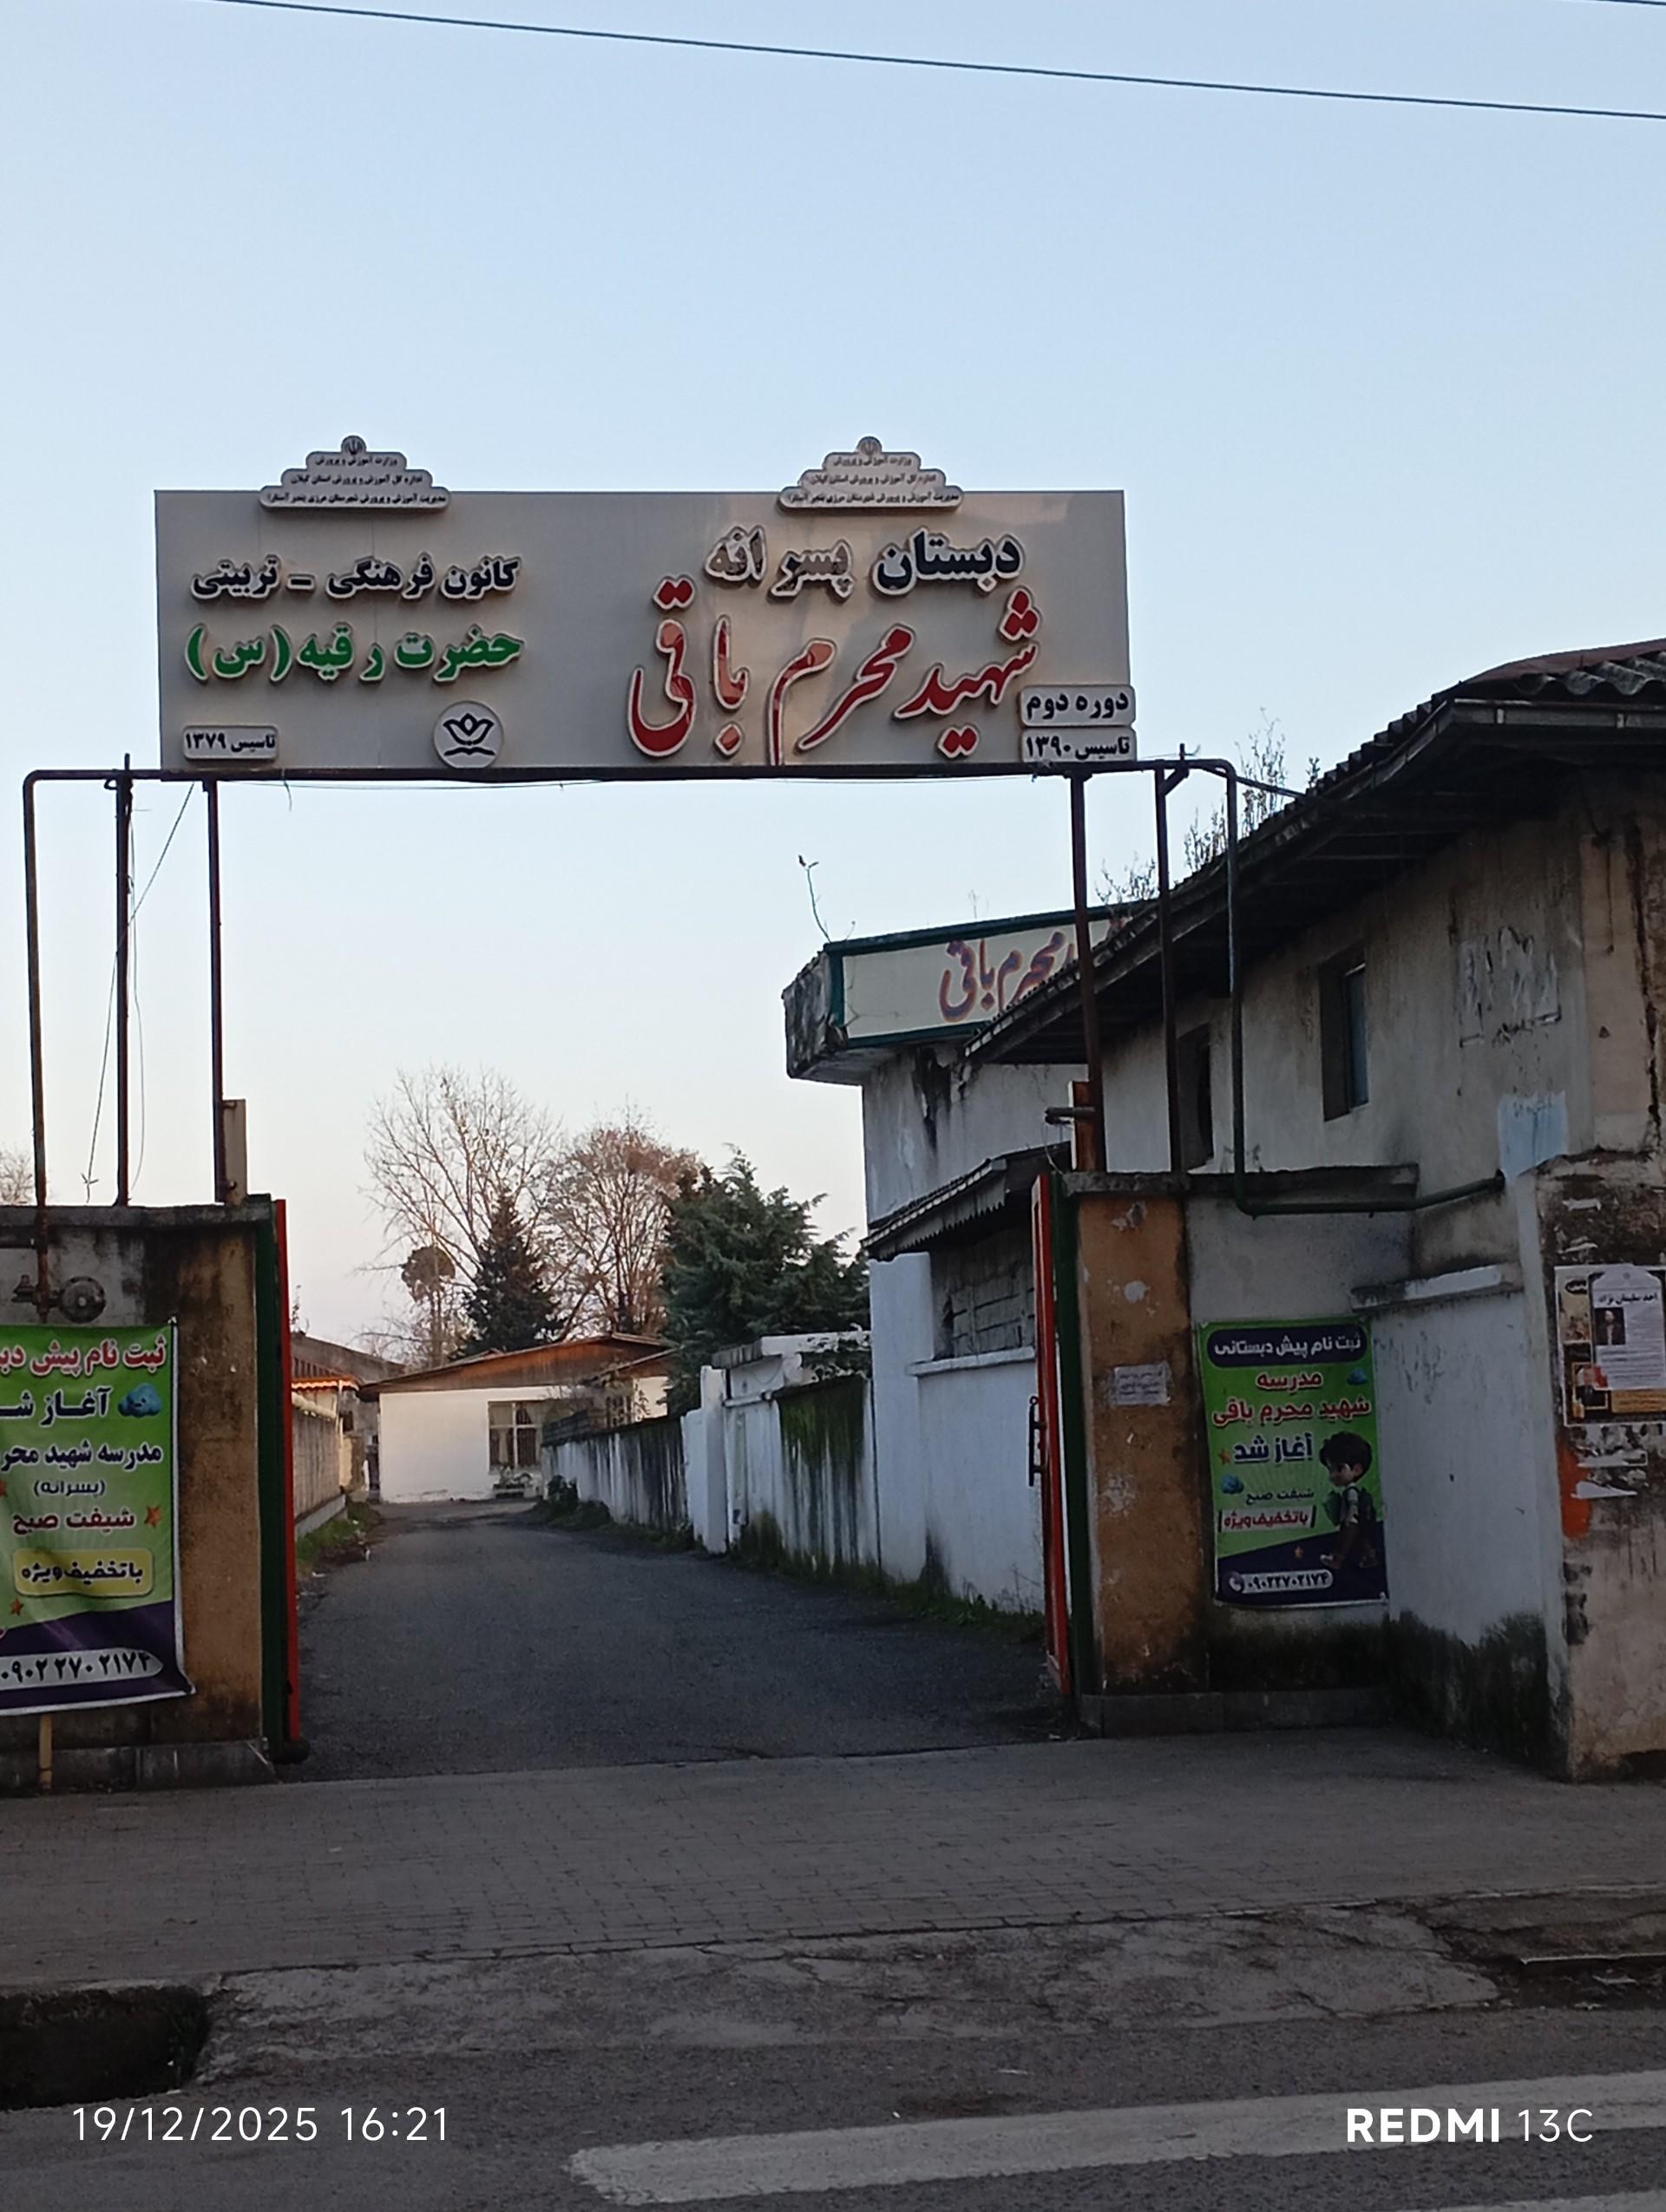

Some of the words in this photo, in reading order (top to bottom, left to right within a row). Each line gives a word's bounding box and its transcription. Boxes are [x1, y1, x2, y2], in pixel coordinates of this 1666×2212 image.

[326, 552, 435, 599] فرهنگی
[873, 527, 1025, 596] دبستان
[191, 554, 280, 599] تربیتی
[442, 557, 519, 599] کانون
[395, 625, 524, 684] حضرت
[627, 575, 750, 757] باقی
[894, 586, 1041, 758] شهید
[769, 624, 915, 765] محرم
[1026, 692, 1069, 720] دوم
[1075, 692, 1129, 719] دوره
[184, 733, 226, 750] ۱۳۷۹
[230, 733, 276, 753] تاسیس
[1026, 735, 1071, 757] ۱۳۹۰
[1075, 736, 1130, 760] تاسیس
[123, 1335, 167, 1373] ثبت
[1214, 1340, 1273, 1358] دبستانی
[1276, 1334, 1309, 1358] پیش
[1310, 1335, 1333, 1356] نام
[1335, 1332, 1361, 1352] ثبت
[30, 1339, 81, 1377] پیش
[85, 1339, 119, 1374] نام
[1256, 1371, 1324, 1394] مدرسه
[0, 1390, 36, 1417] ش
[40, 1384, 112, 1426] آغاز
[1212, 1397, 1255, 1430] باقی
[1260, 1401, 1314, 1427] محرم
[1318, 1395, 1372, 1423] شهید
[0, 1444, 40, 1473] محر
[45, 1438, 94, 1472] شهید
[97, 1441, 163, 1472] مدرسه
[1234, 1436, 1270, 1463] شد
[1275, 1433, 1313, 1463] آغاز
[34, 1478, 106, 1499] (پسرانه)
[1245, 1490, 1273, 1505] صبح
[1276, 1488, 1315, 1502] شیفت
[12, 1511, 60, 1537] صبح
[65, 1507, 137, 1535] شیفت
